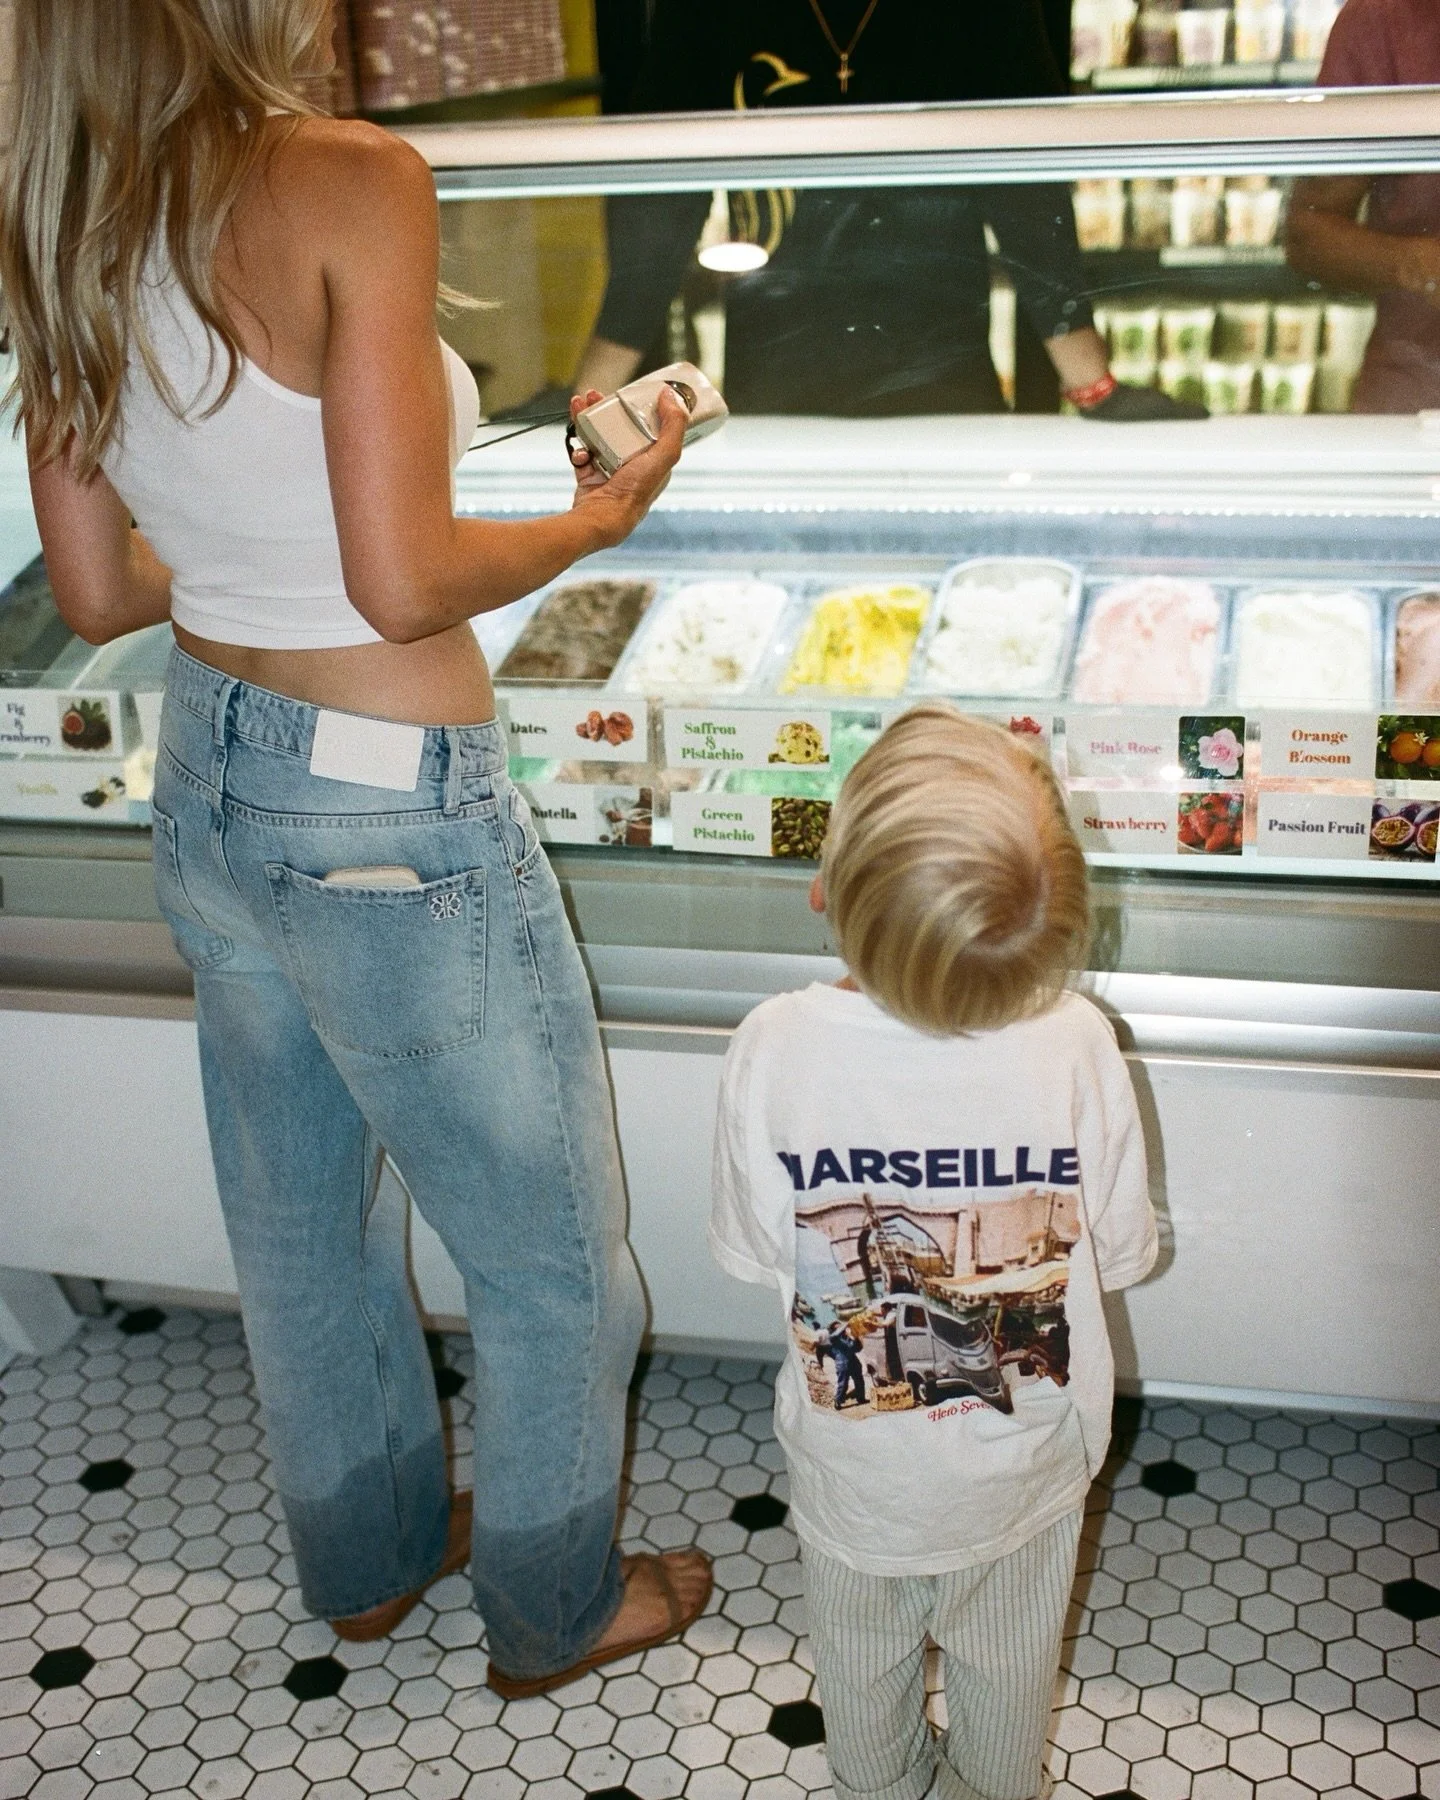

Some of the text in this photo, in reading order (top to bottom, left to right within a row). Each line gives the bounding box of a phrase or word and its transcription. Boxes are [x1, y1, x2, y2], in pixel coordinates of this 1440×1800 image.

[510, 721, 547, 734] Dates
[684, 722, 736, 735] Saffron
[0, 731, 51, 748] ranberry
[705, 736, 716, 749] &
[1291, 729, 1348, 745] Orange
[681, 747, 744, 761] Pistachio
[1127, 741, 1162, 755] Rose
[530, 805, 577, 820] Nutella
[701, 808, 743, 821] Green
[1083, 816, 1168, 833] Strawberry
[1268, 819, 1367, 835] Passion Fruit
[693, 827, 755, 842] Pistachio
[928, 1400, 994, 1421] Hero Seve
